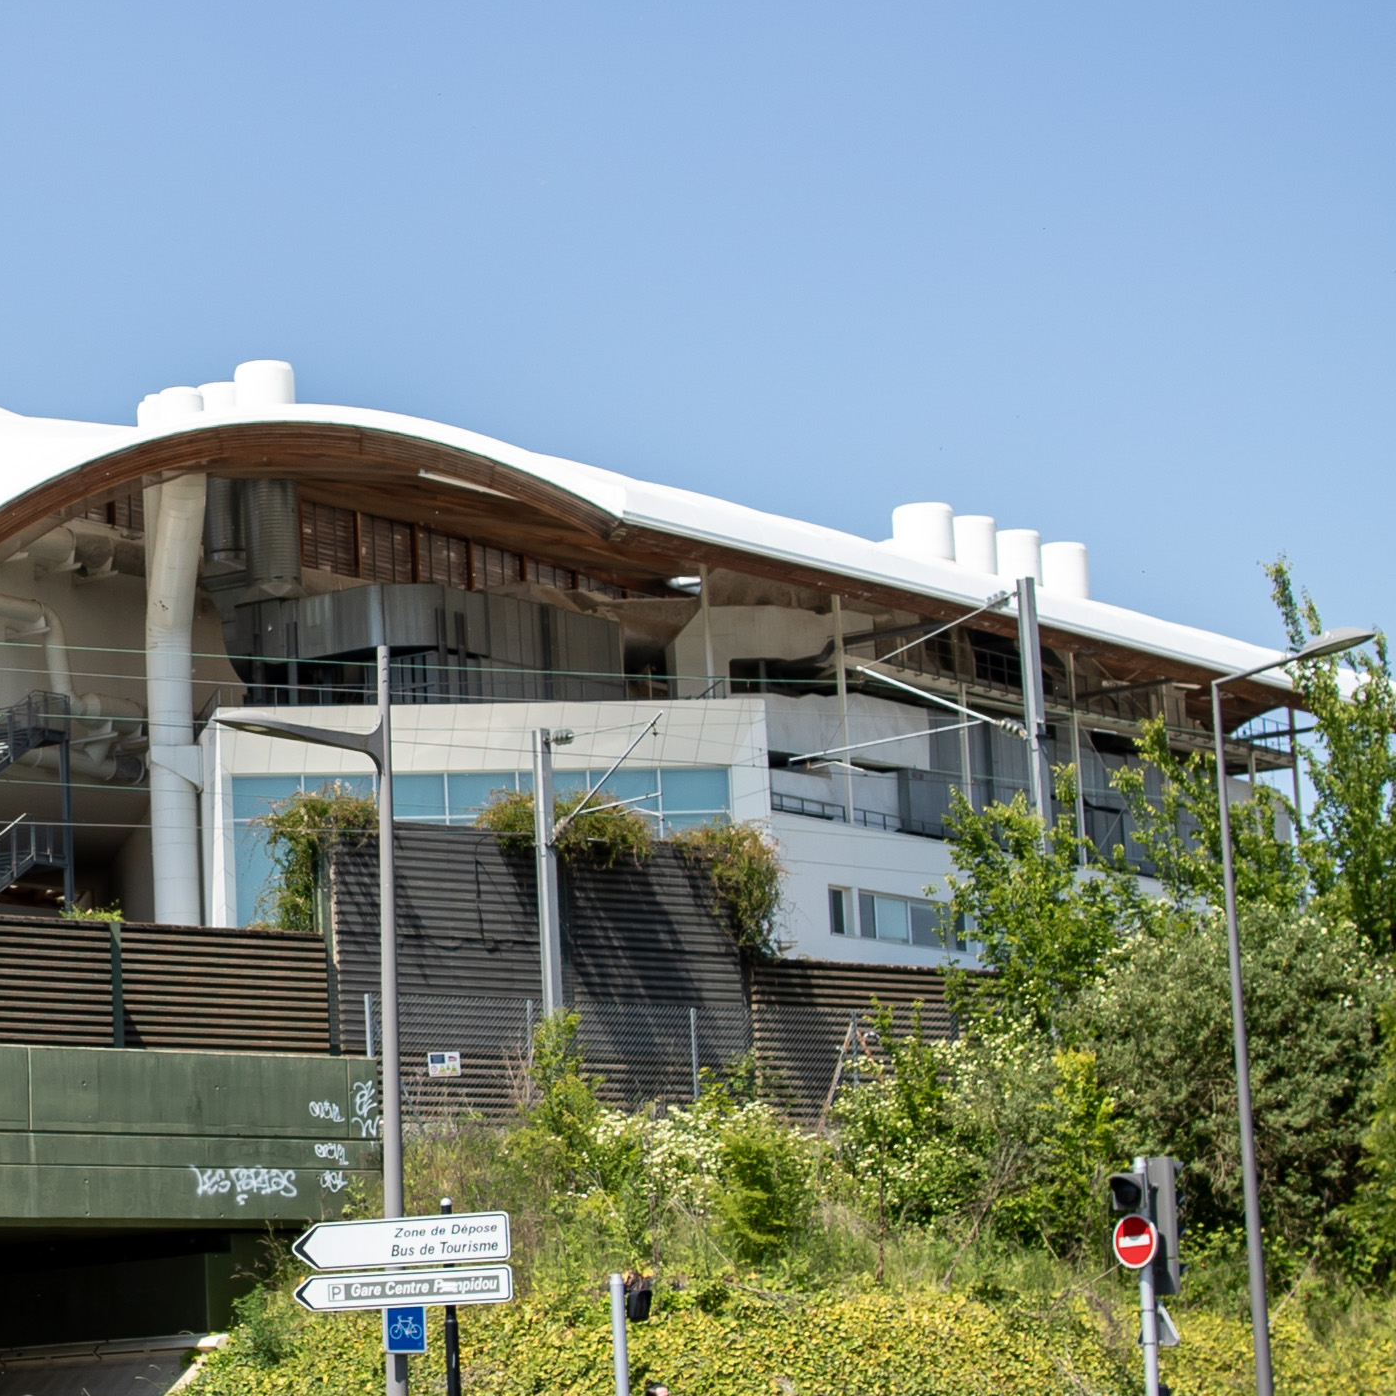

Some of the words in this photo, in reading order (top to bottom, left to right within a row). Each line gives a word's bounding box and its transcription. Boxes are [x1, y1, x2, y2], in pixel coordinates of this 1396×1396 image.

[394, 1227, 426, 1239] Zone
[431, 1225, 446, 1237] de
[451, 1223, 498, 1238] Dépose
[391, 1244, 415, 1258] Bus
[419, 1243, 435, 1256] de
[440, 1240, 498, 1255] Tourisme
[350, 1282, 382, 1298] Gare
[385, 1280, 430, 1297] Centre
